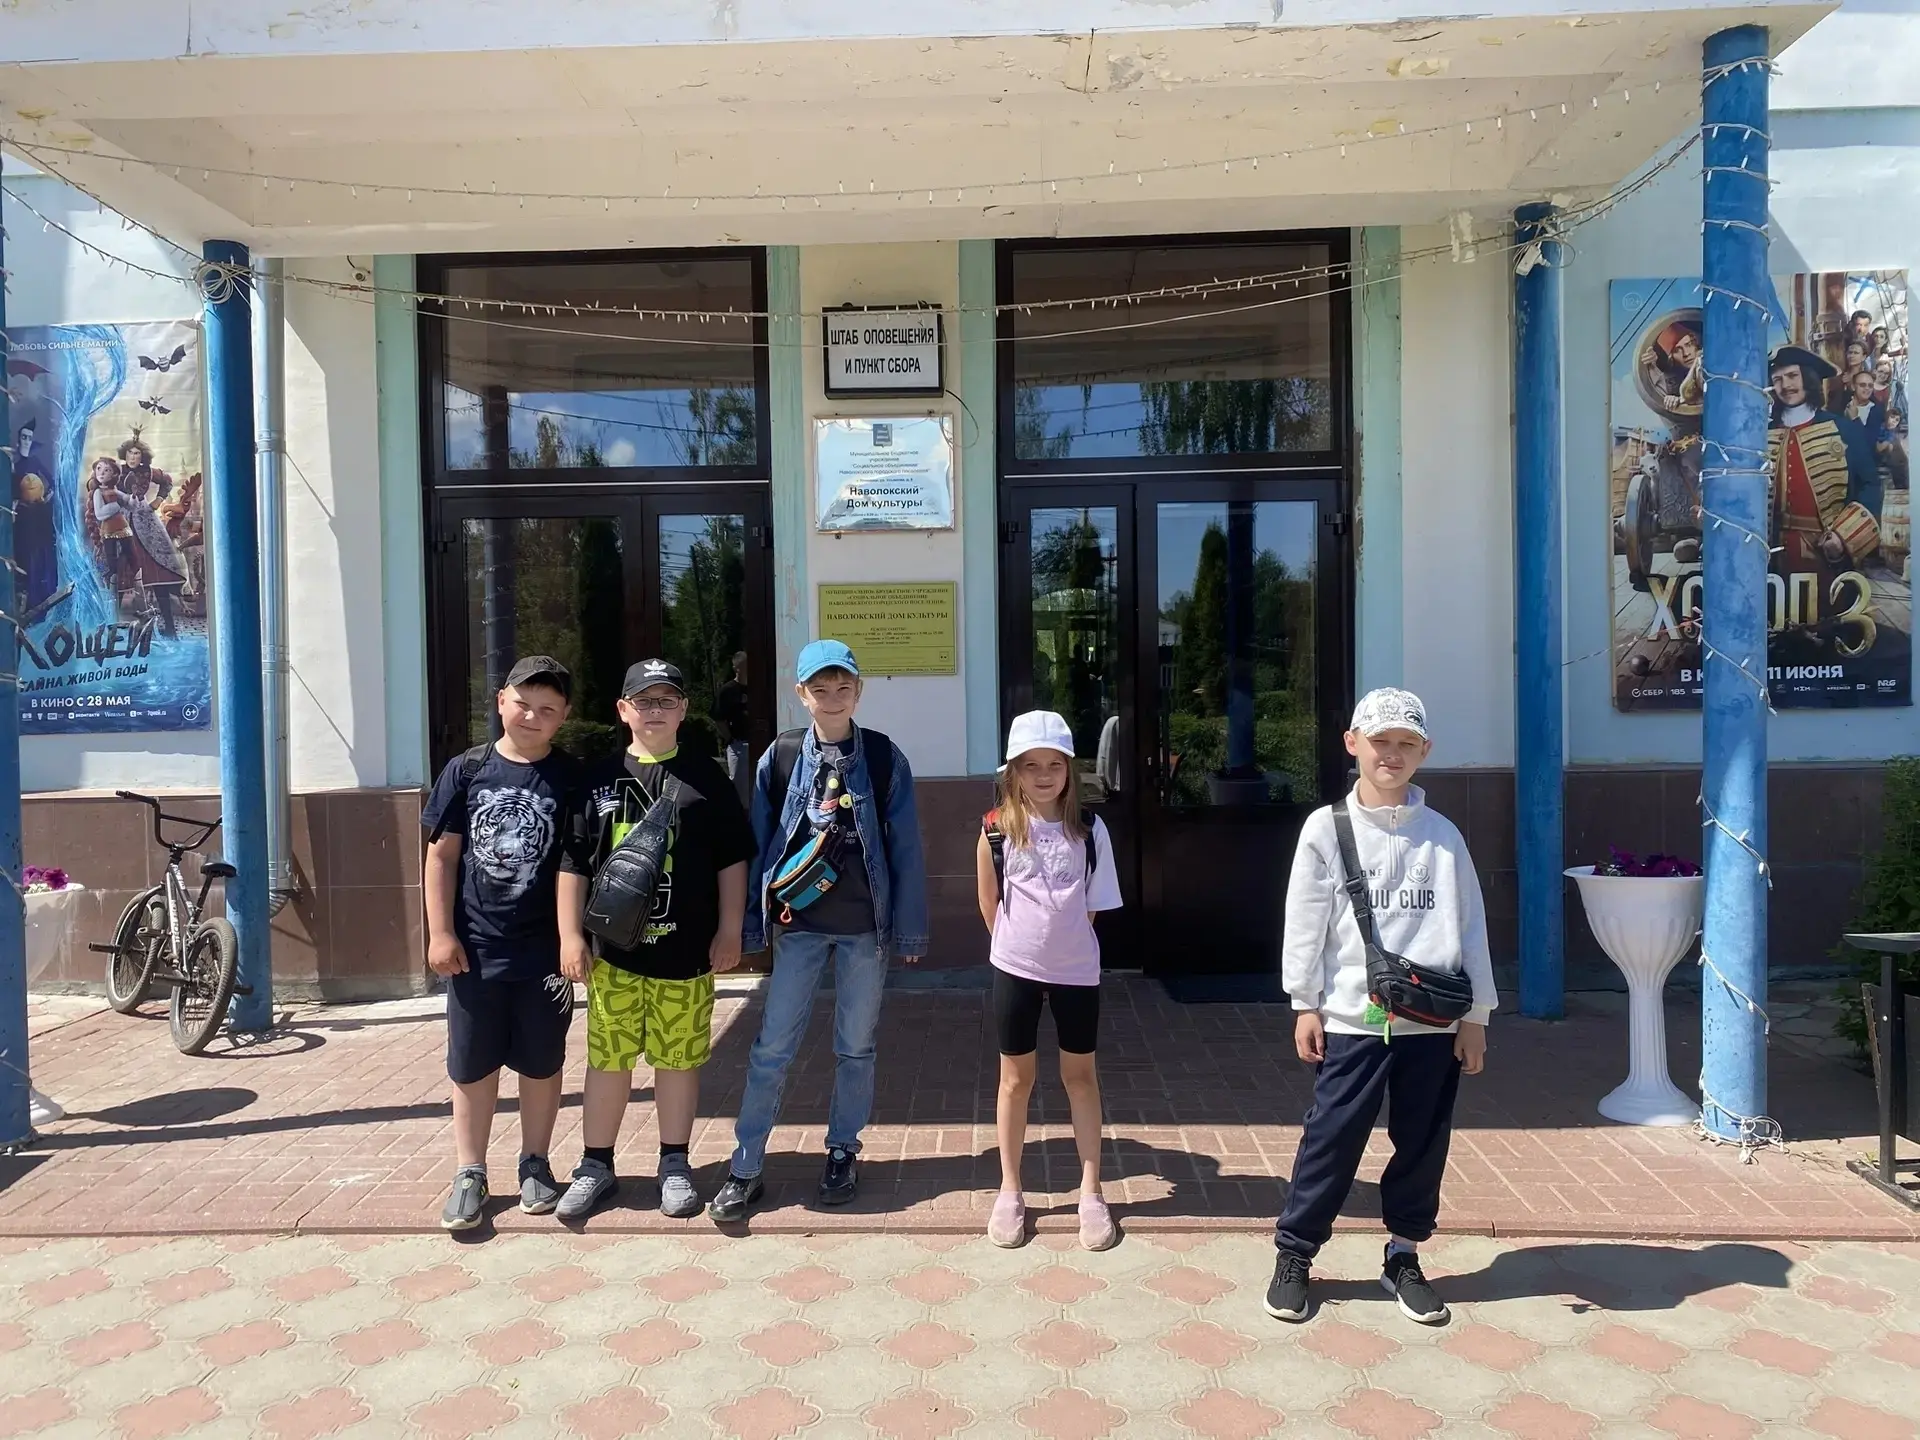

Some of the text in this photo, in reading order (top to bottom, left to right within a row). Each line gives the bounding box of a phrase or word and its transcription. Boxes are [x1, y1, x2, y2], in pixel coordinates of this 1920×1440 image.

[830, 327, 934, 345] ШТАБ ОПОВЕЩЕНИЯ
[10, 342, 47, 352] ЛЮБОВЬ
[48, 341, 85, 350] СИЛЬНЕЕ
[844, 357, 921, 374] И ПУНКТ СБОРА
[846, 499, 923, 510] Дом культуры
[826, 611, 949, 620] НАВОЛОКСКИЙ ДОМ КУЛЬТУРЫ
[1647, 571, 1877, 659] ХООП 3
[66, 667, 111, 687] ЖИВОЙ
[115, 663, 149, 678] ВОДЫ
[1680, 668, 1693, 682] В
[1785, 664, 1844, 680] ИЮНЯ
[31, 695, 131, 708] В КИНО С 28 МАЯ
[185, 706, 197, 717] 6+
[1399, 889, 1436, 910] CLUB
